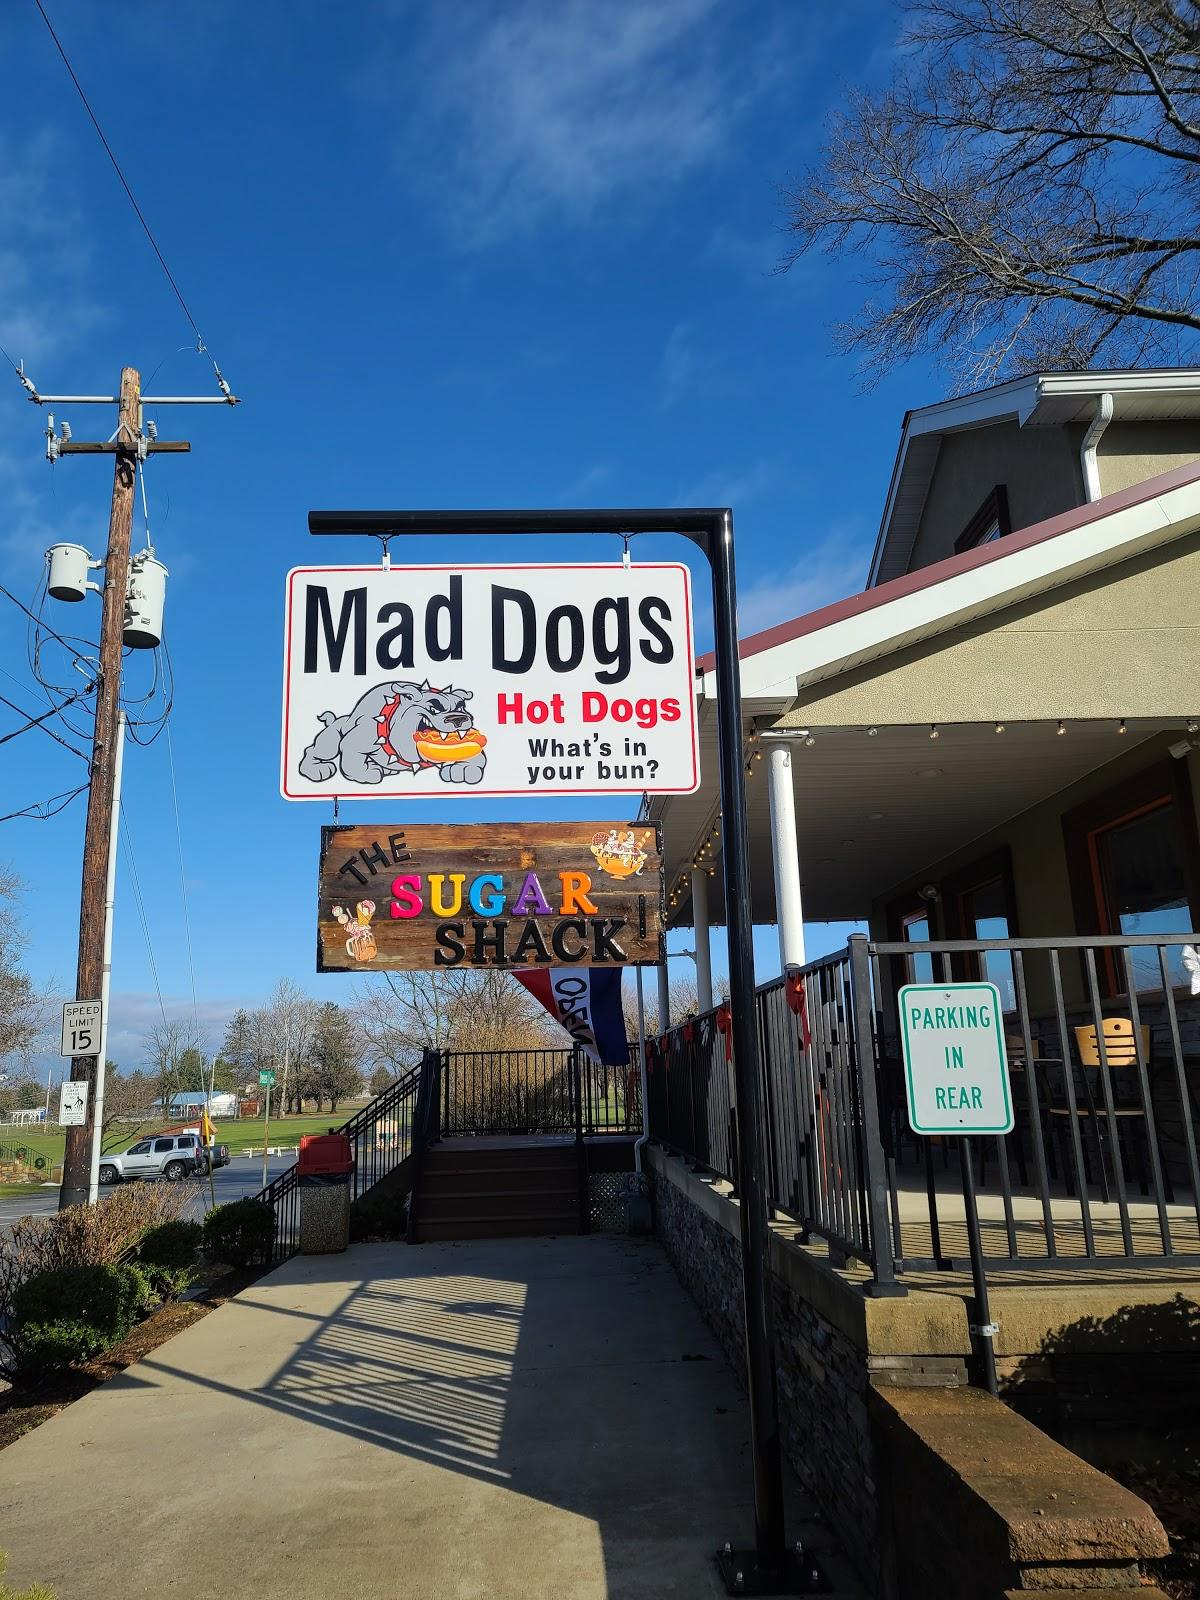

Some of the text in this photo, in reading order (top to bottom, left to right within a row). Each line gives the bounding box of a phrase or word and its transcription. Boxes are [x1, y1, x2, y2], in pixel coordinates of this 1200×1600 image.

[304, 575, 674, 685] Mad Dogs
[498, 691, 682, 729] Hot Dogs
[528, 733, 647, 757] What's in
[528, 759, 659, 785] your bun?
[339, 832, 412, 885] THE
[390, 871, 598, 920] SUGAR
[66, 1006, 99, 1016] SPEED
[70, 1018, 95, 1027] LIMIT
[911, 1005, 991, 1030] PARKING
[71, 1029, 91, 1050] 15
[945, 1046, 965, 1069] IN
[935, 1086, 984, 1110] REAR
